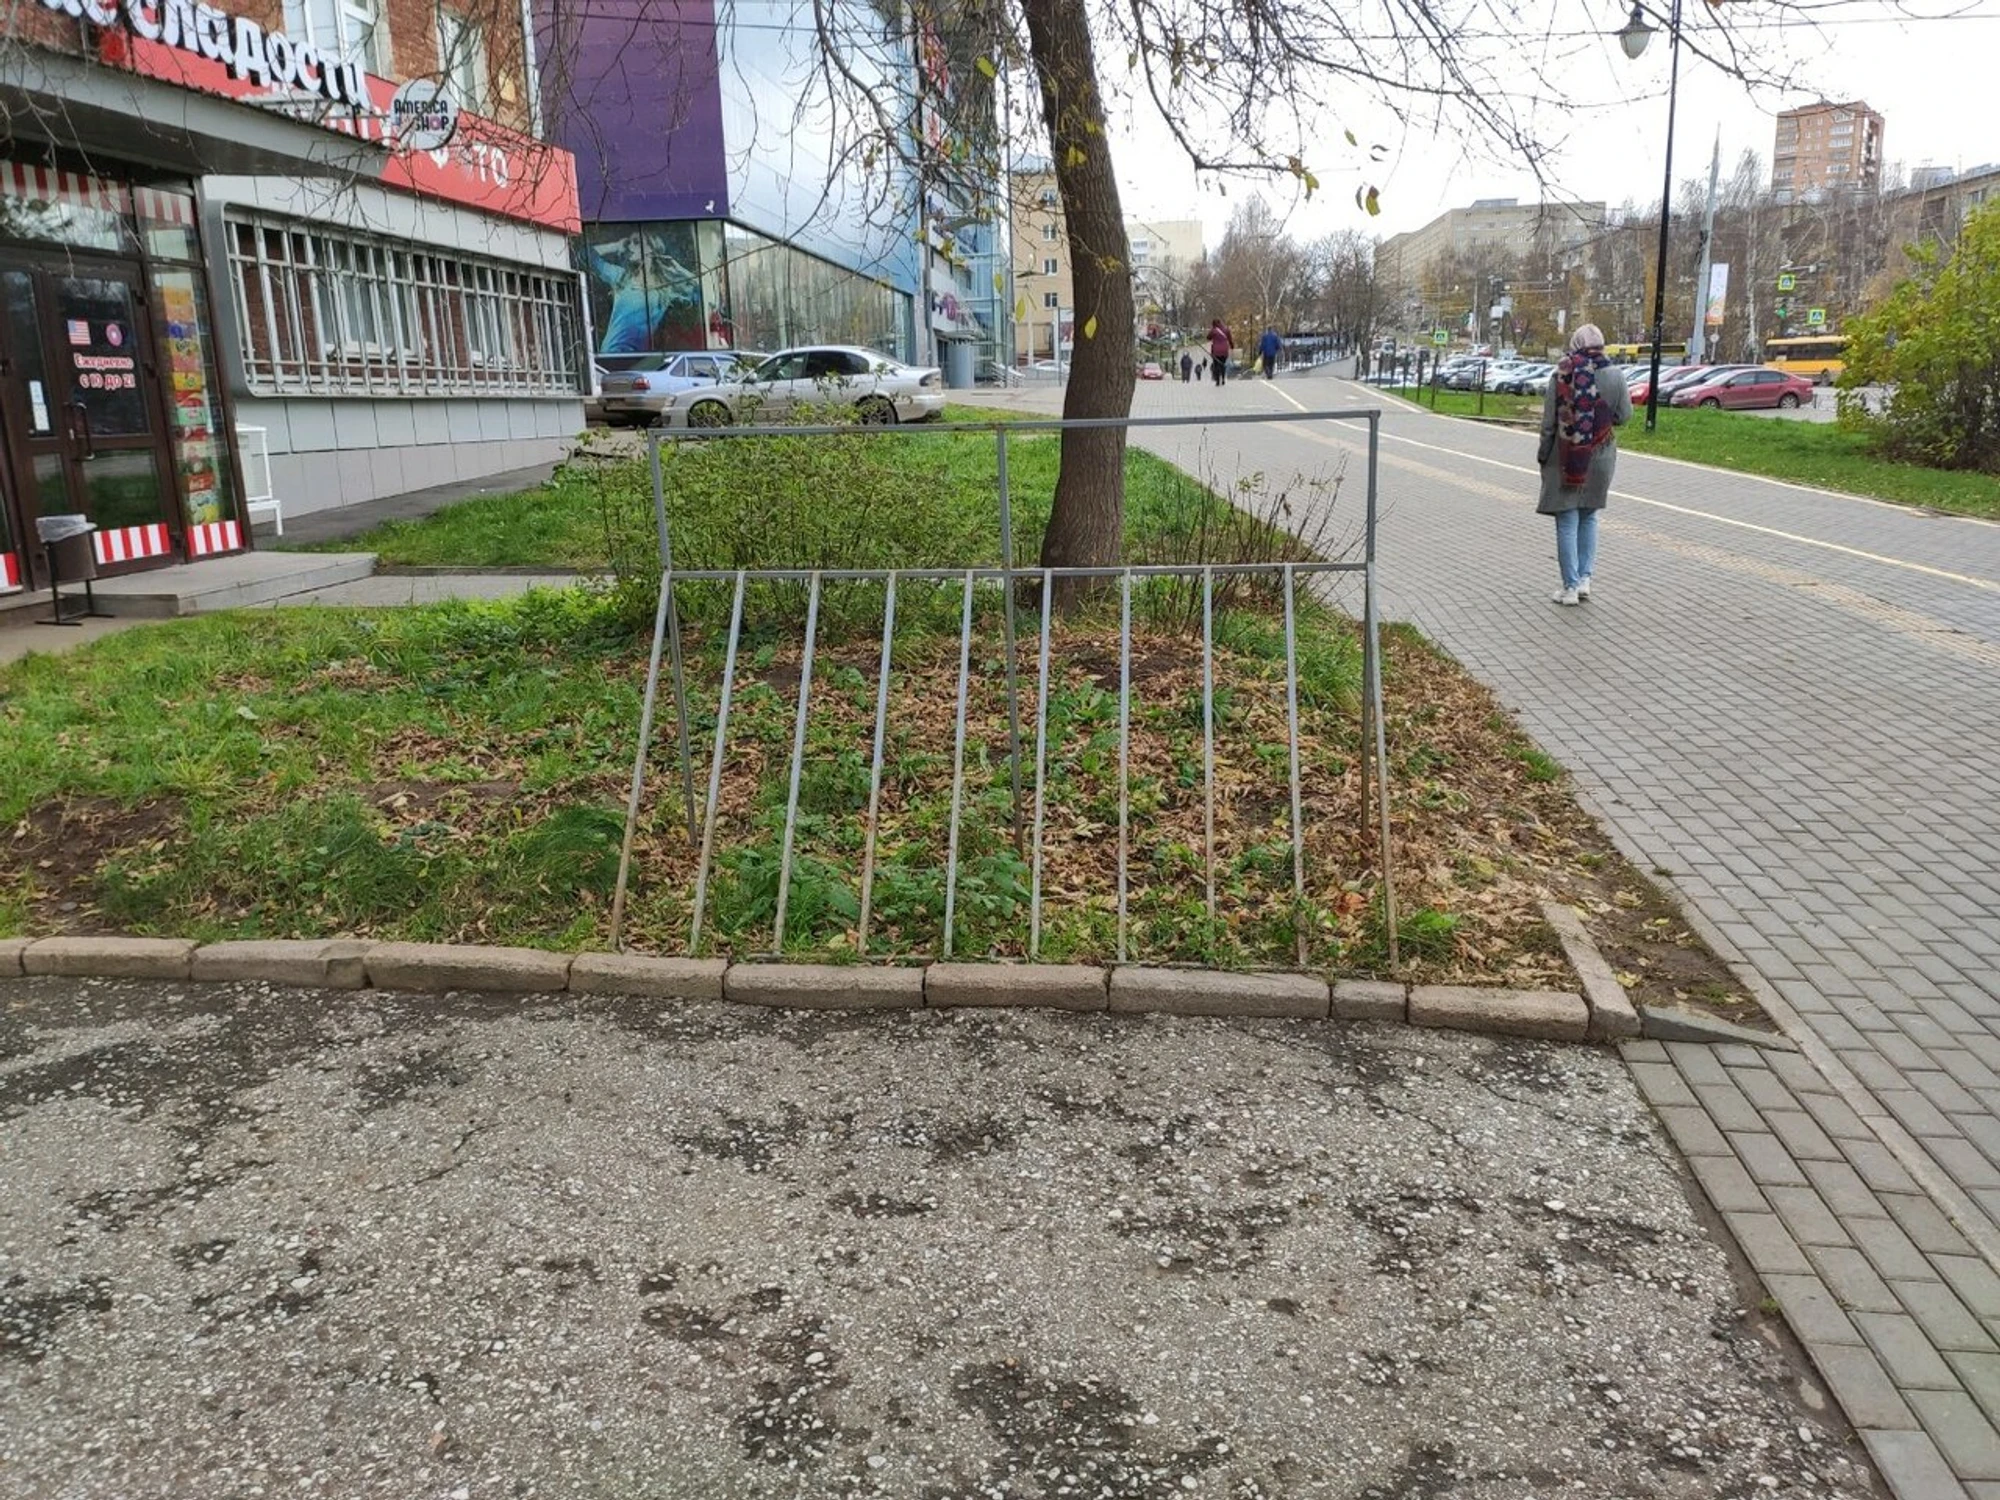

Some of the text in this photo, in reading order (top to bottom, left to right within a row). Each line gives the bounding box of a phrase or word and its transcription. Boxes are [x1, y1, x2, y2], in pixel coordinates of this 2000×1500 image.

[74, 352, 134, 371] Ежедневно
[90, 373, 104, 388] 10
[122, 373, 136, 388] 21
